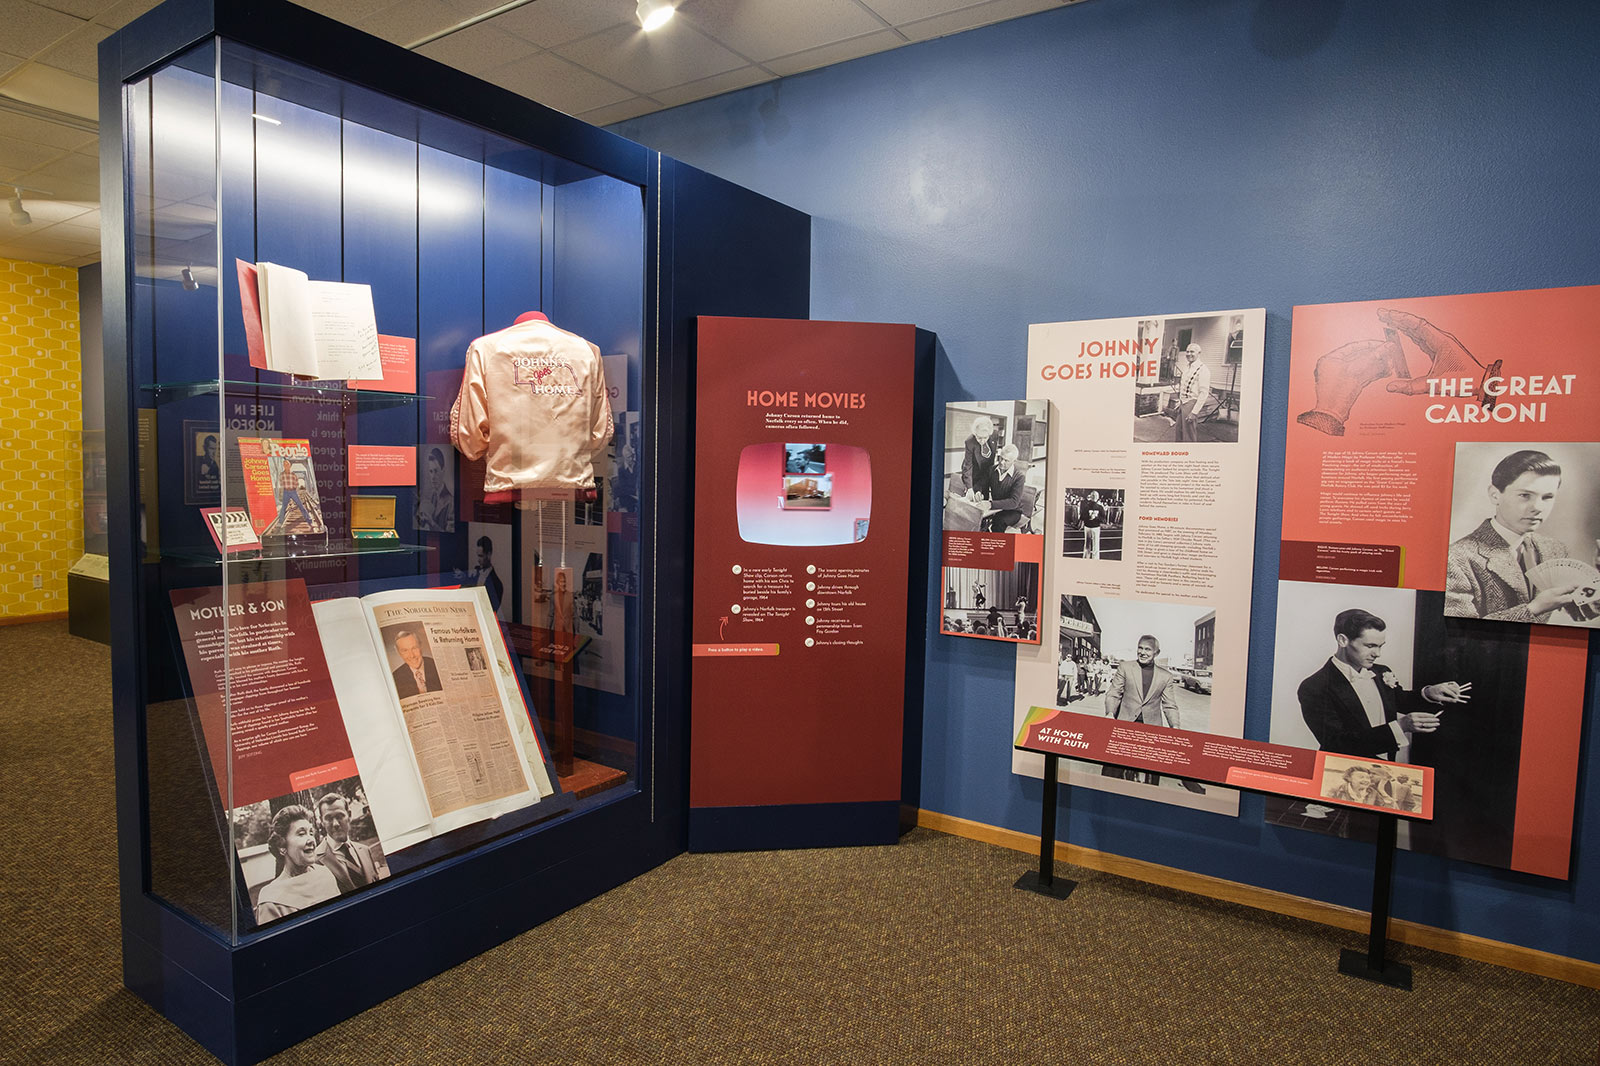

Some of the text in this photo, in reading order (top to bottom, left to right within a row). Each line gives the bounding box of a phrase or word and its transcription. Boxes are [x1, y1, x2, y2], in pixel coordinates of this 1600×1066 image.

[1078, 338, 1159, 358] JOHNNY
[514, 358, 572, 368] JOHNNY
[1041, 360, 1157, 380] GOES HOME
[533, 368, 552, 384] goes
[534, 386, 576, 395] HOME
[1426, 374, 1576, 397] THE GREAT
[747, 390, 866, 409] HOME MOVIES
[1425, 402, 1547, 424] CARSONI
[270, 444, 308, 459] People
[248, 603, 258, 614] &
[261, 600, 285, 612] SON
[1038, 734, 1089, 749] WITH RUTH
[1054, 729, 1084, 740] HOME
